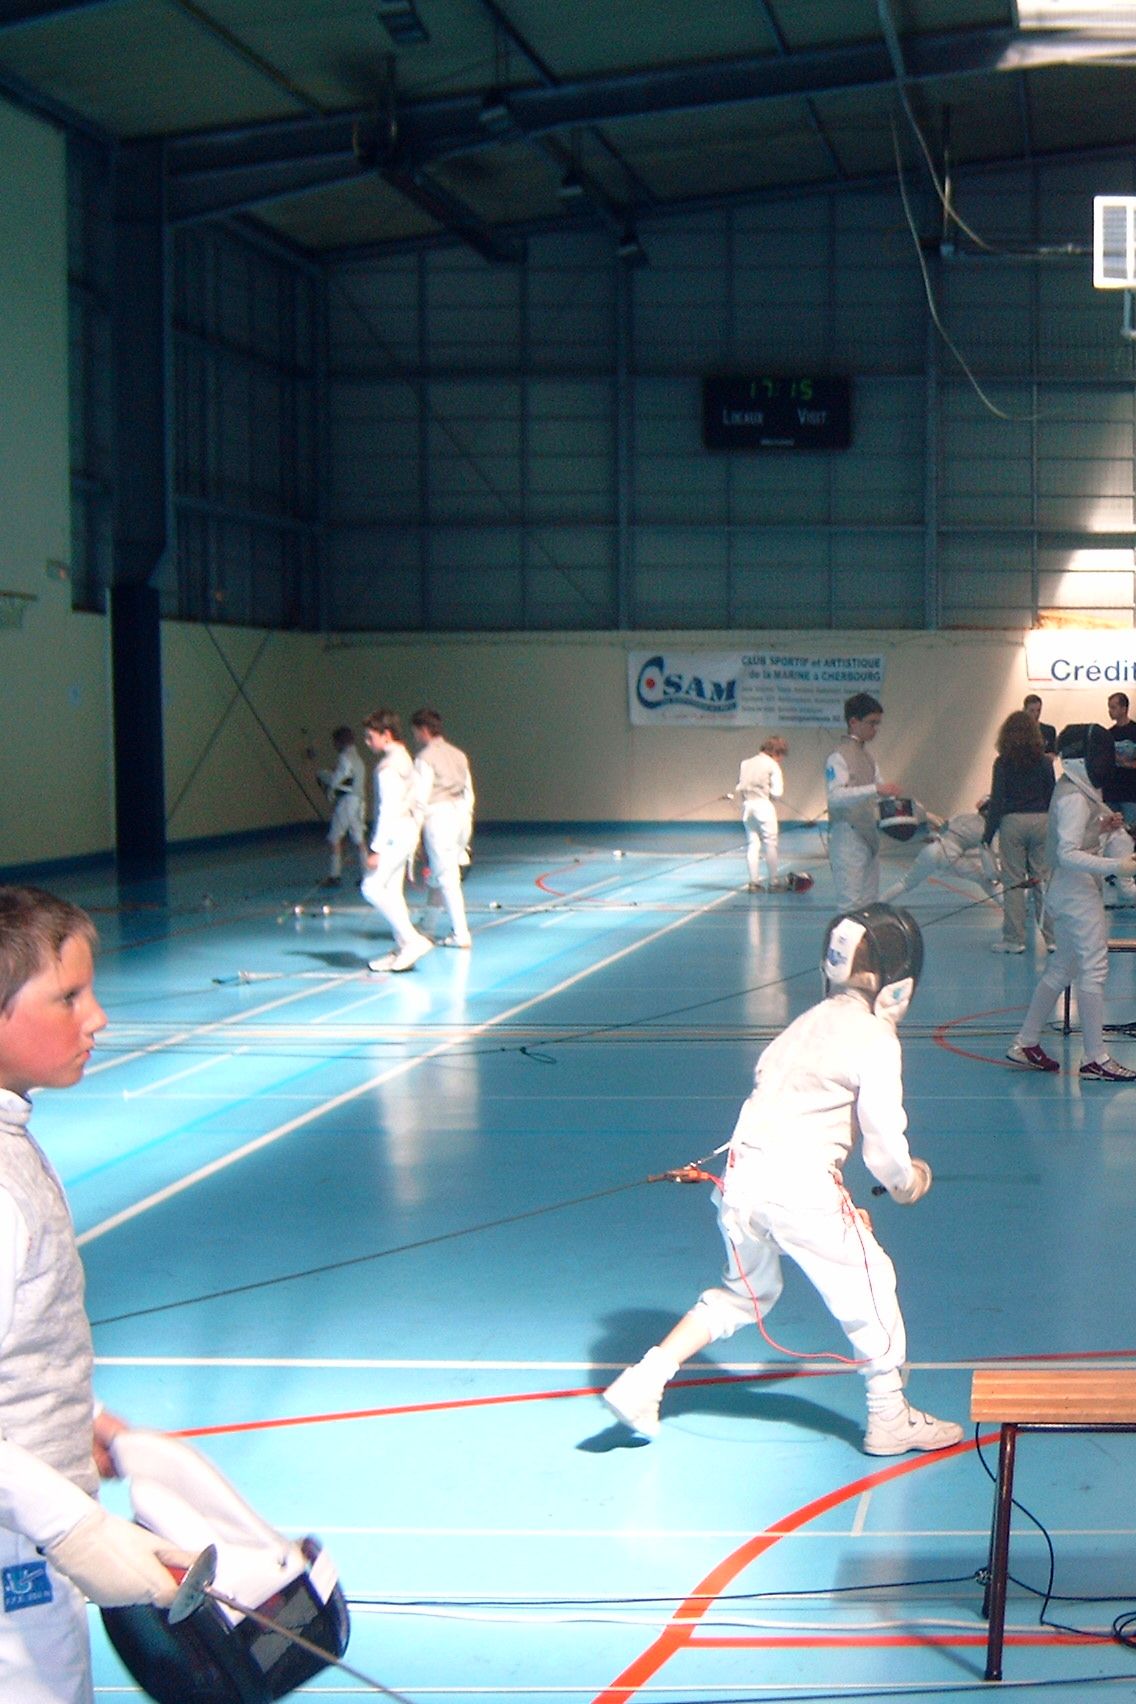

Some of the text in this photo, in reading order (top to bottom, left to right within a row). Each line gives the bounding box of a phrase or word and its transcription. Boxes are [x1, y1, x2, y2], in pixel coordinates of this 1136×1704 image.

[741, 655, 767, 666] CLUB
[823, 658, 881, 669] ARTISTIQUE
[774, 670, 811, 681] MARINE
[821, 670, 881, 682] CHERBOURG
